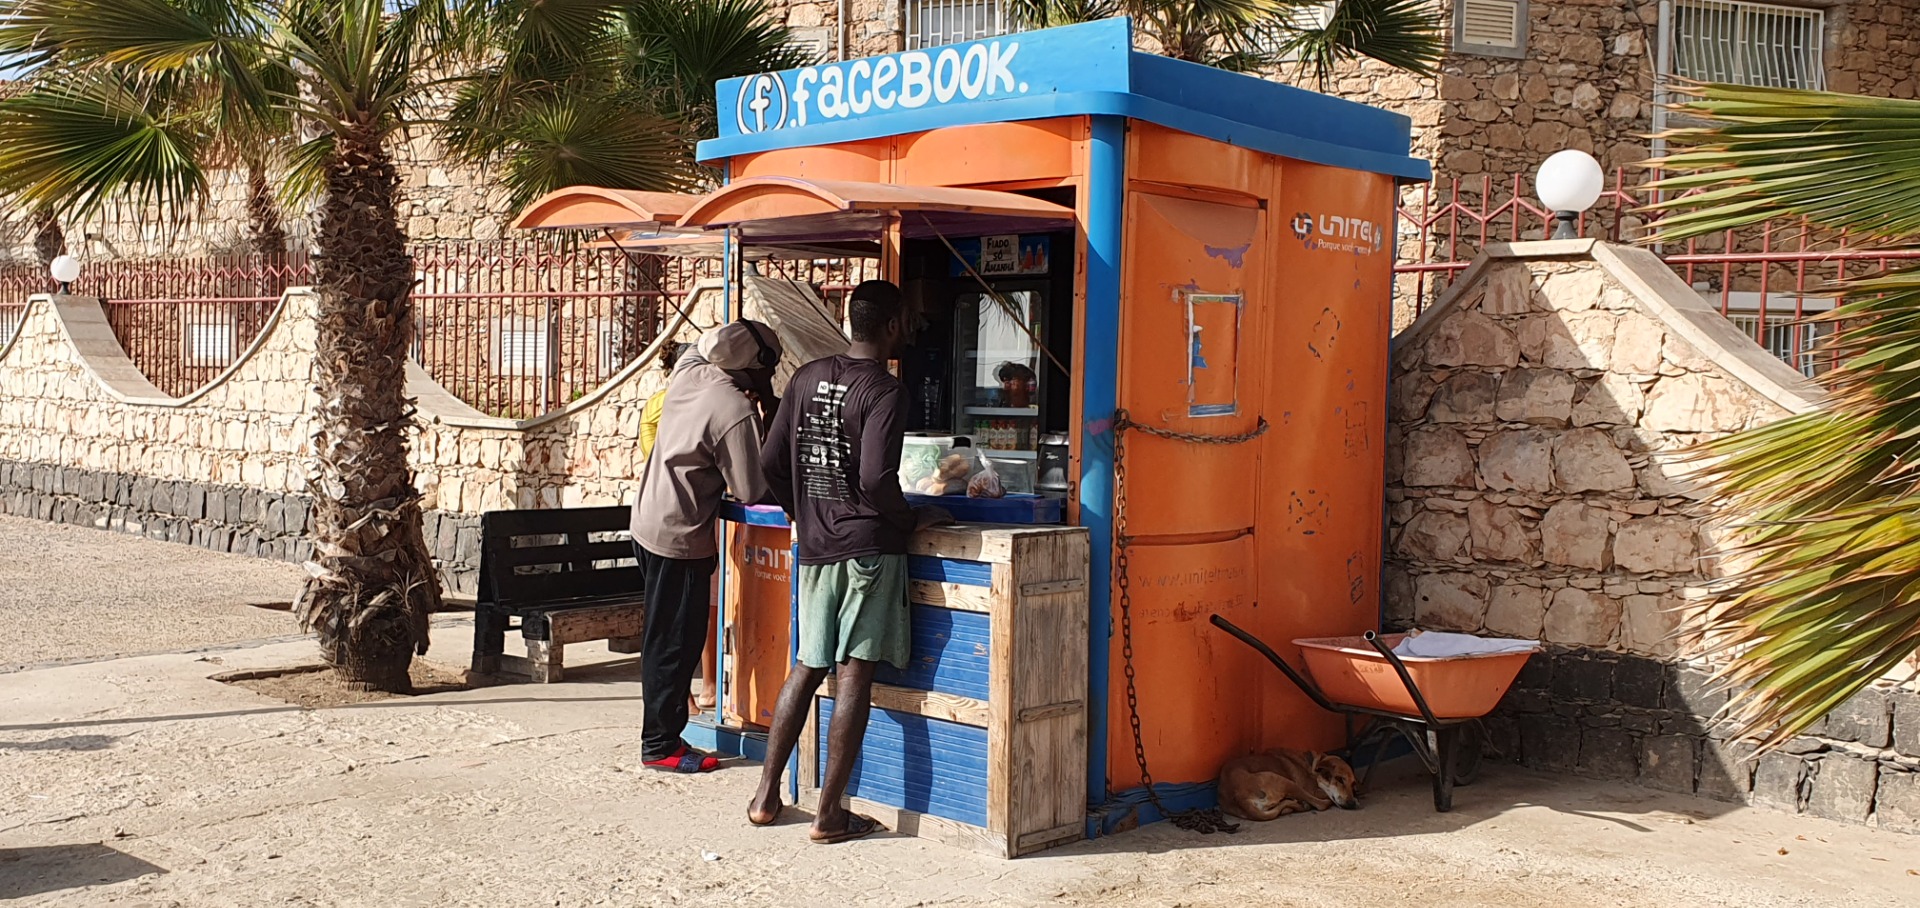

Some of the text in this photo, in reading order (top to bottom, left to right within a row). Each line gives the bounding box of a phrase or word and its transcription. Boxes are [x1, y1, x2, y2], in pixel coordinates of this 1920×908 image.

[1319, 214, 1372, 243] UNITEL
[987, 238, 1009, 249] FIADO
[1318, 239, 1341, 252] Porque
